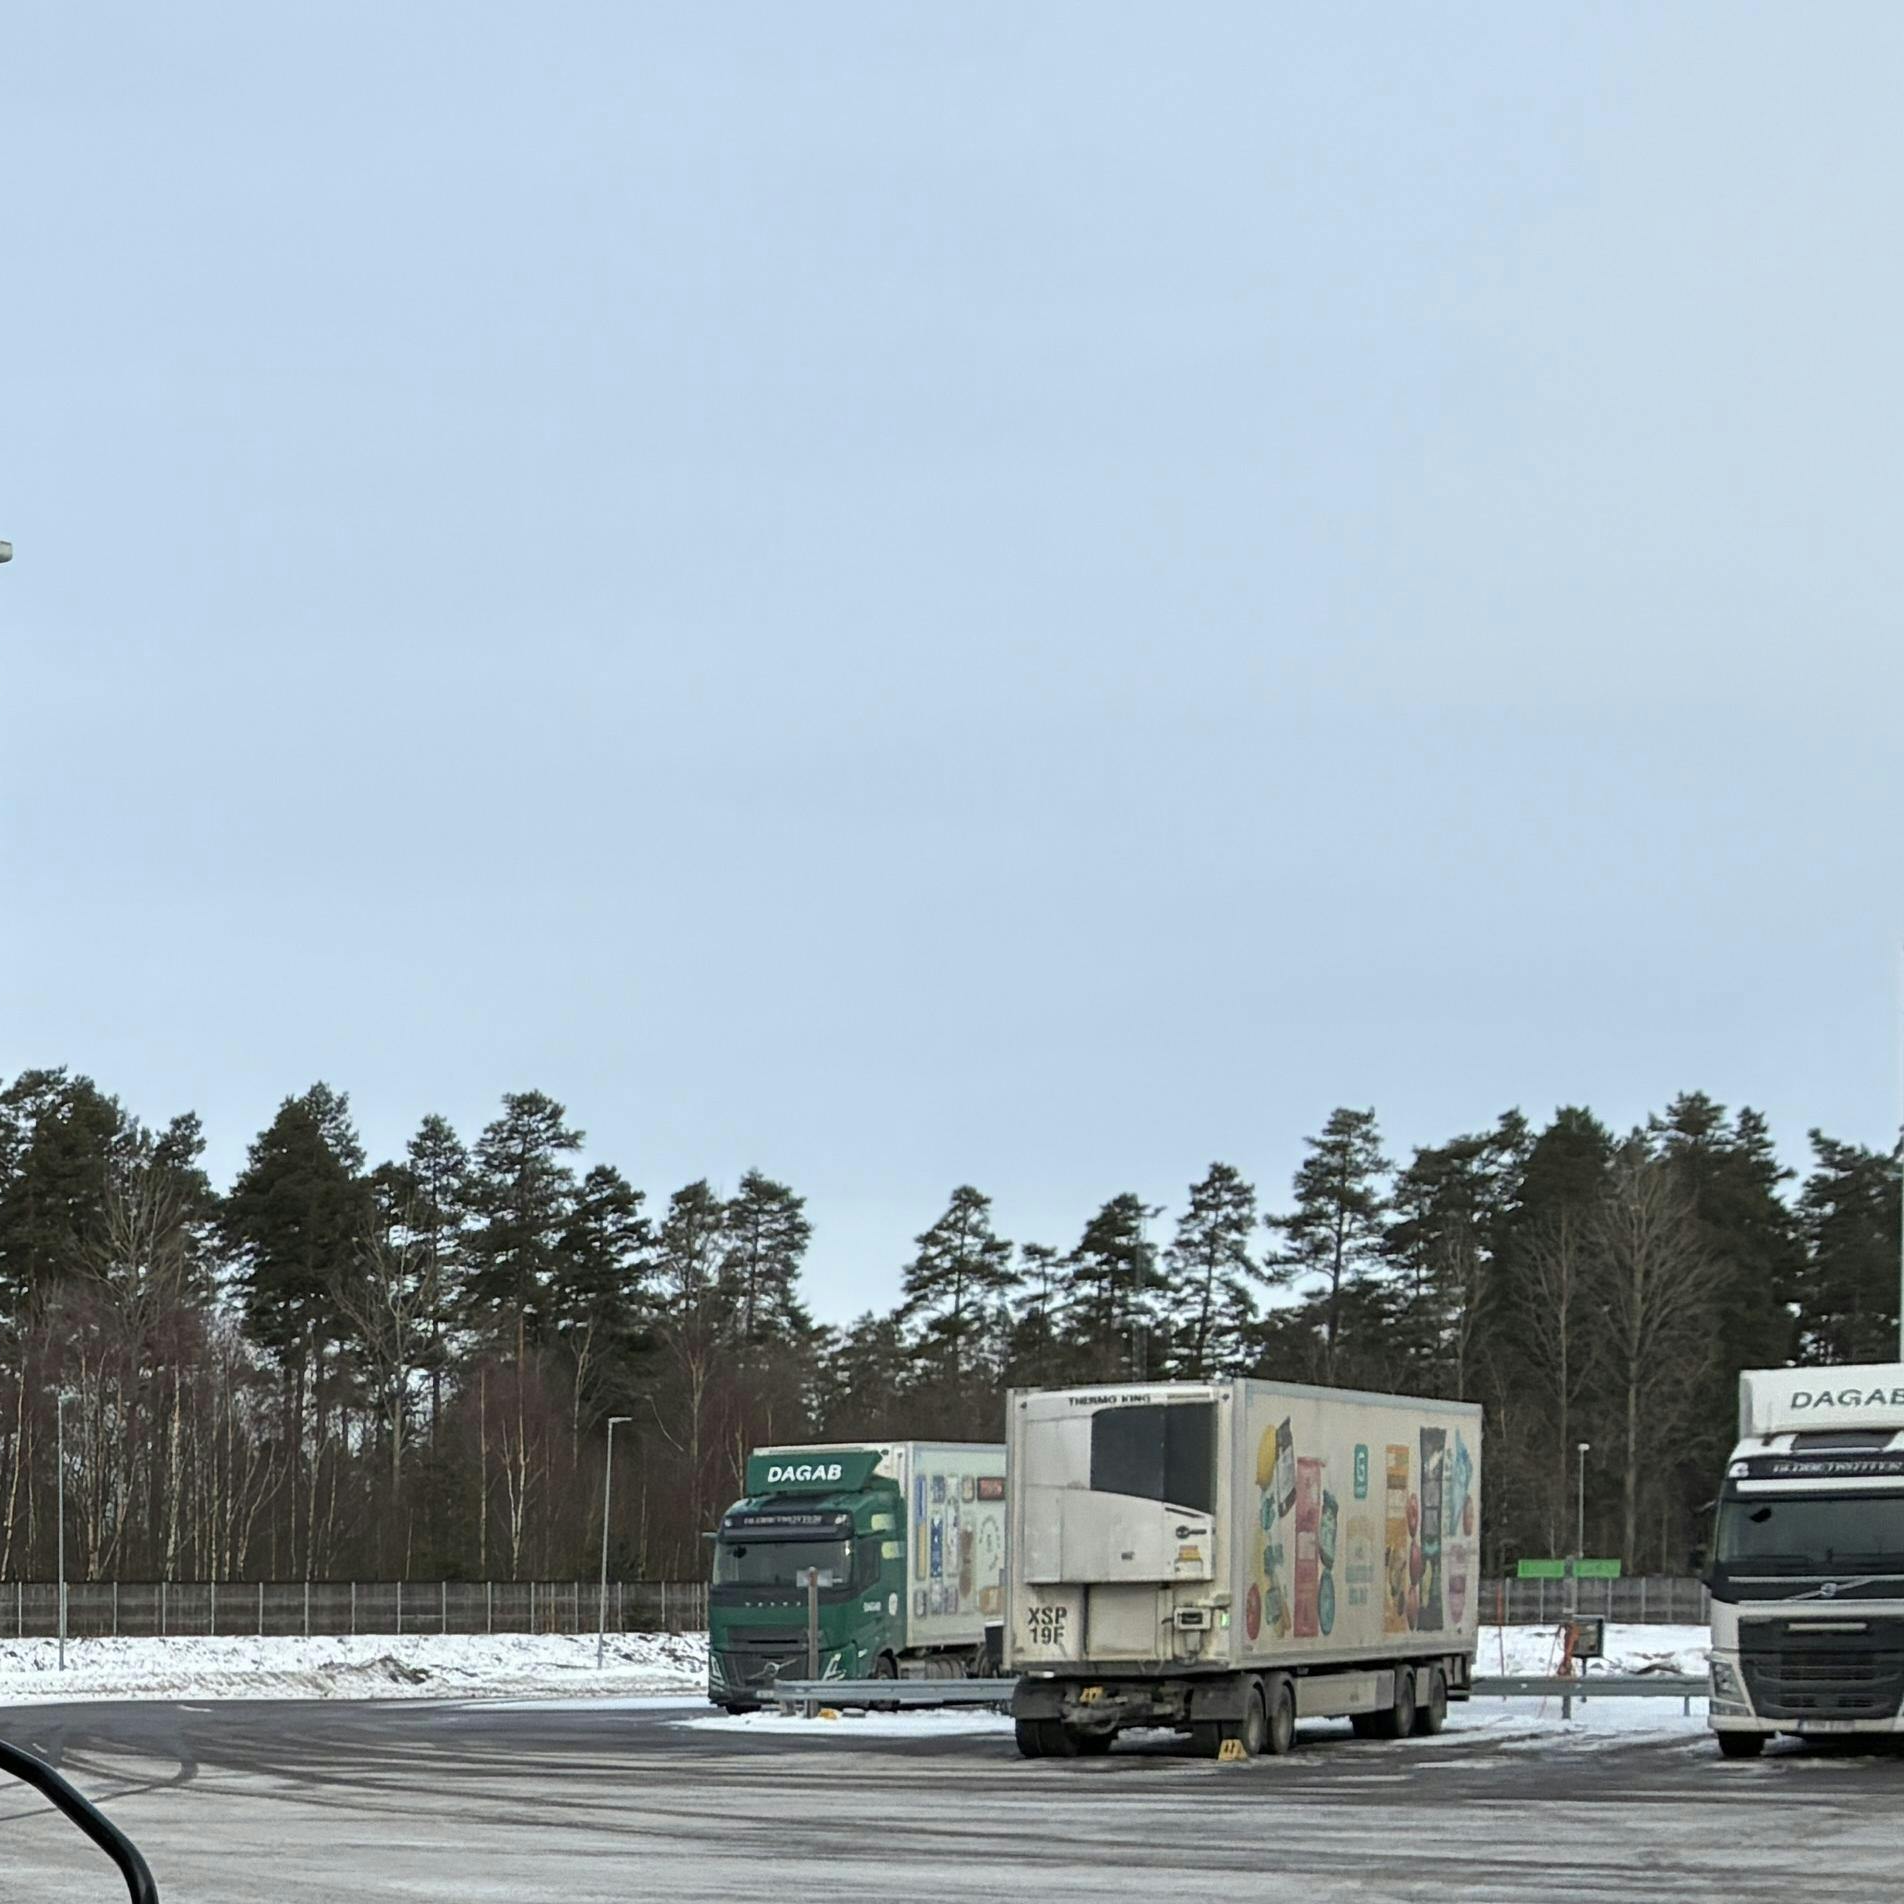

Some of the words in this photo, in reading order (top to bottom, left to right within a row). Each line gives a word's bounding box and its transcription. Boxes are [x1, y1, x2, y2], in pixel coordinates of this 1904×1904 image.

[1790, 1388, 1904, 1409] DAGAB
[767, 1464, 842, 1483] DAGAB
[1028, 1607, 1067, 1625] XSP
